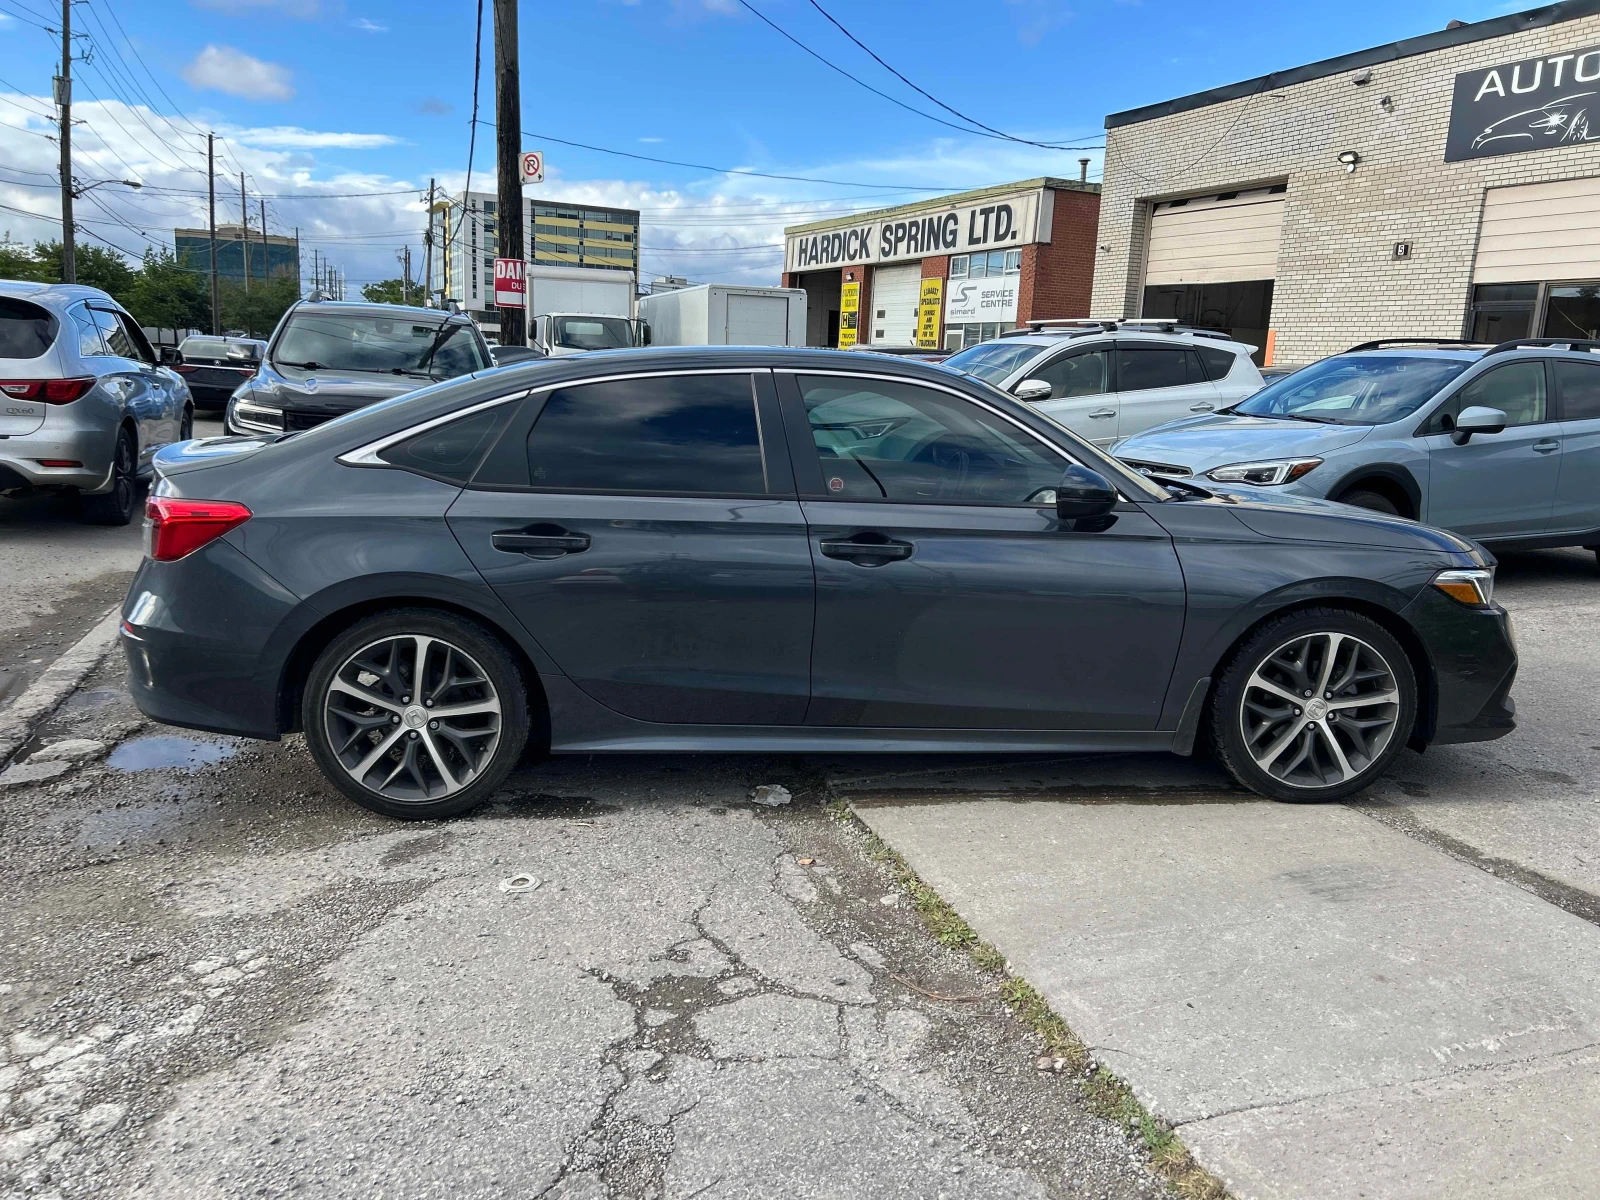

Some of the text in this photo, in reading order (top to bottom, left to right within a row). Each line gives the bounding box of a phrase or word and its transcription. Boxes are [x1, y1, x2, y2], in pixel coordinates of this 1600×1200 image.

[1474, 51, 1600, 102] AUTO
[798, 204, 1017, 267] HARDICK SPRING LTD.
[981, 289, 1014, 298] SERVICE
[981, 299, 1013, 308] CENTRE
[950, 307, 976, 316] simard
